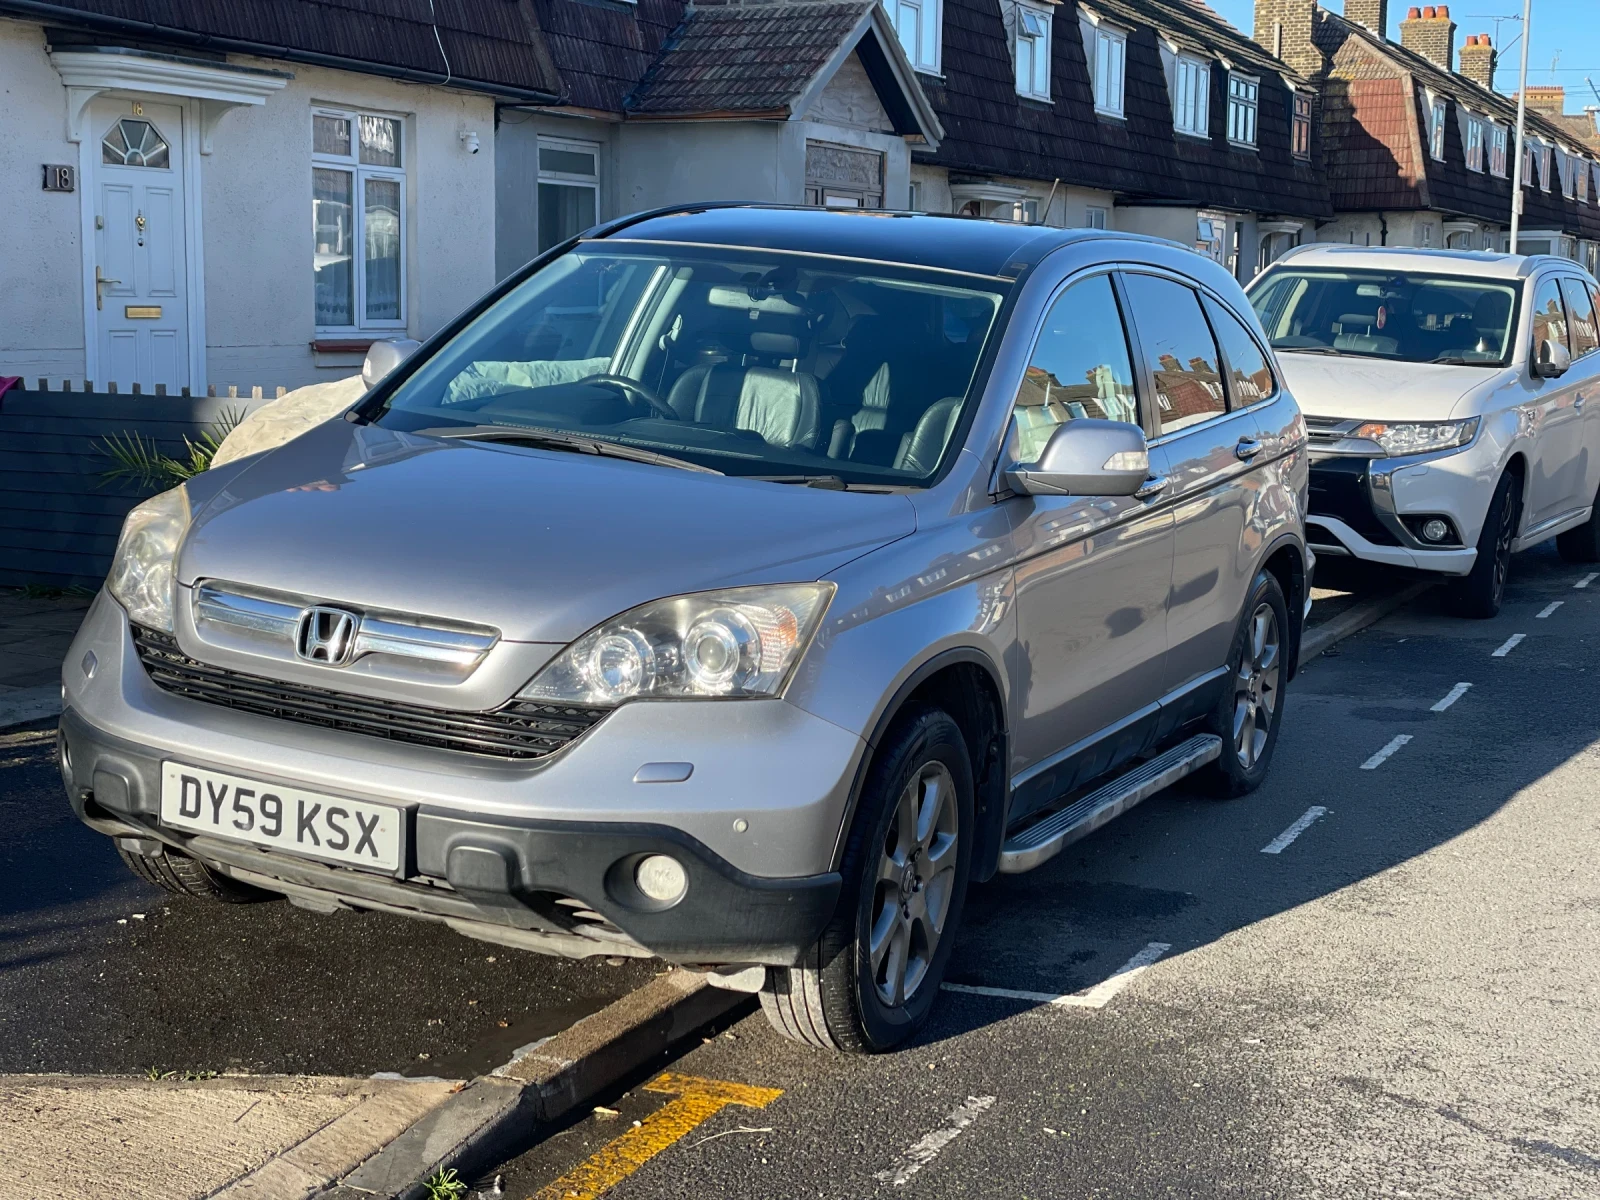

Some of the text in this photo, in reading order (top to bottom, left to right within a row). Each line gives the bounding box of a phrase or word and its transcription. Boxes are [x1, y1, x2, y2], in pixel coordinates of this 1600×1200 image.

[55, 167, 70, 188] 18
[179, 774, 380, 858] DY59 KSX
